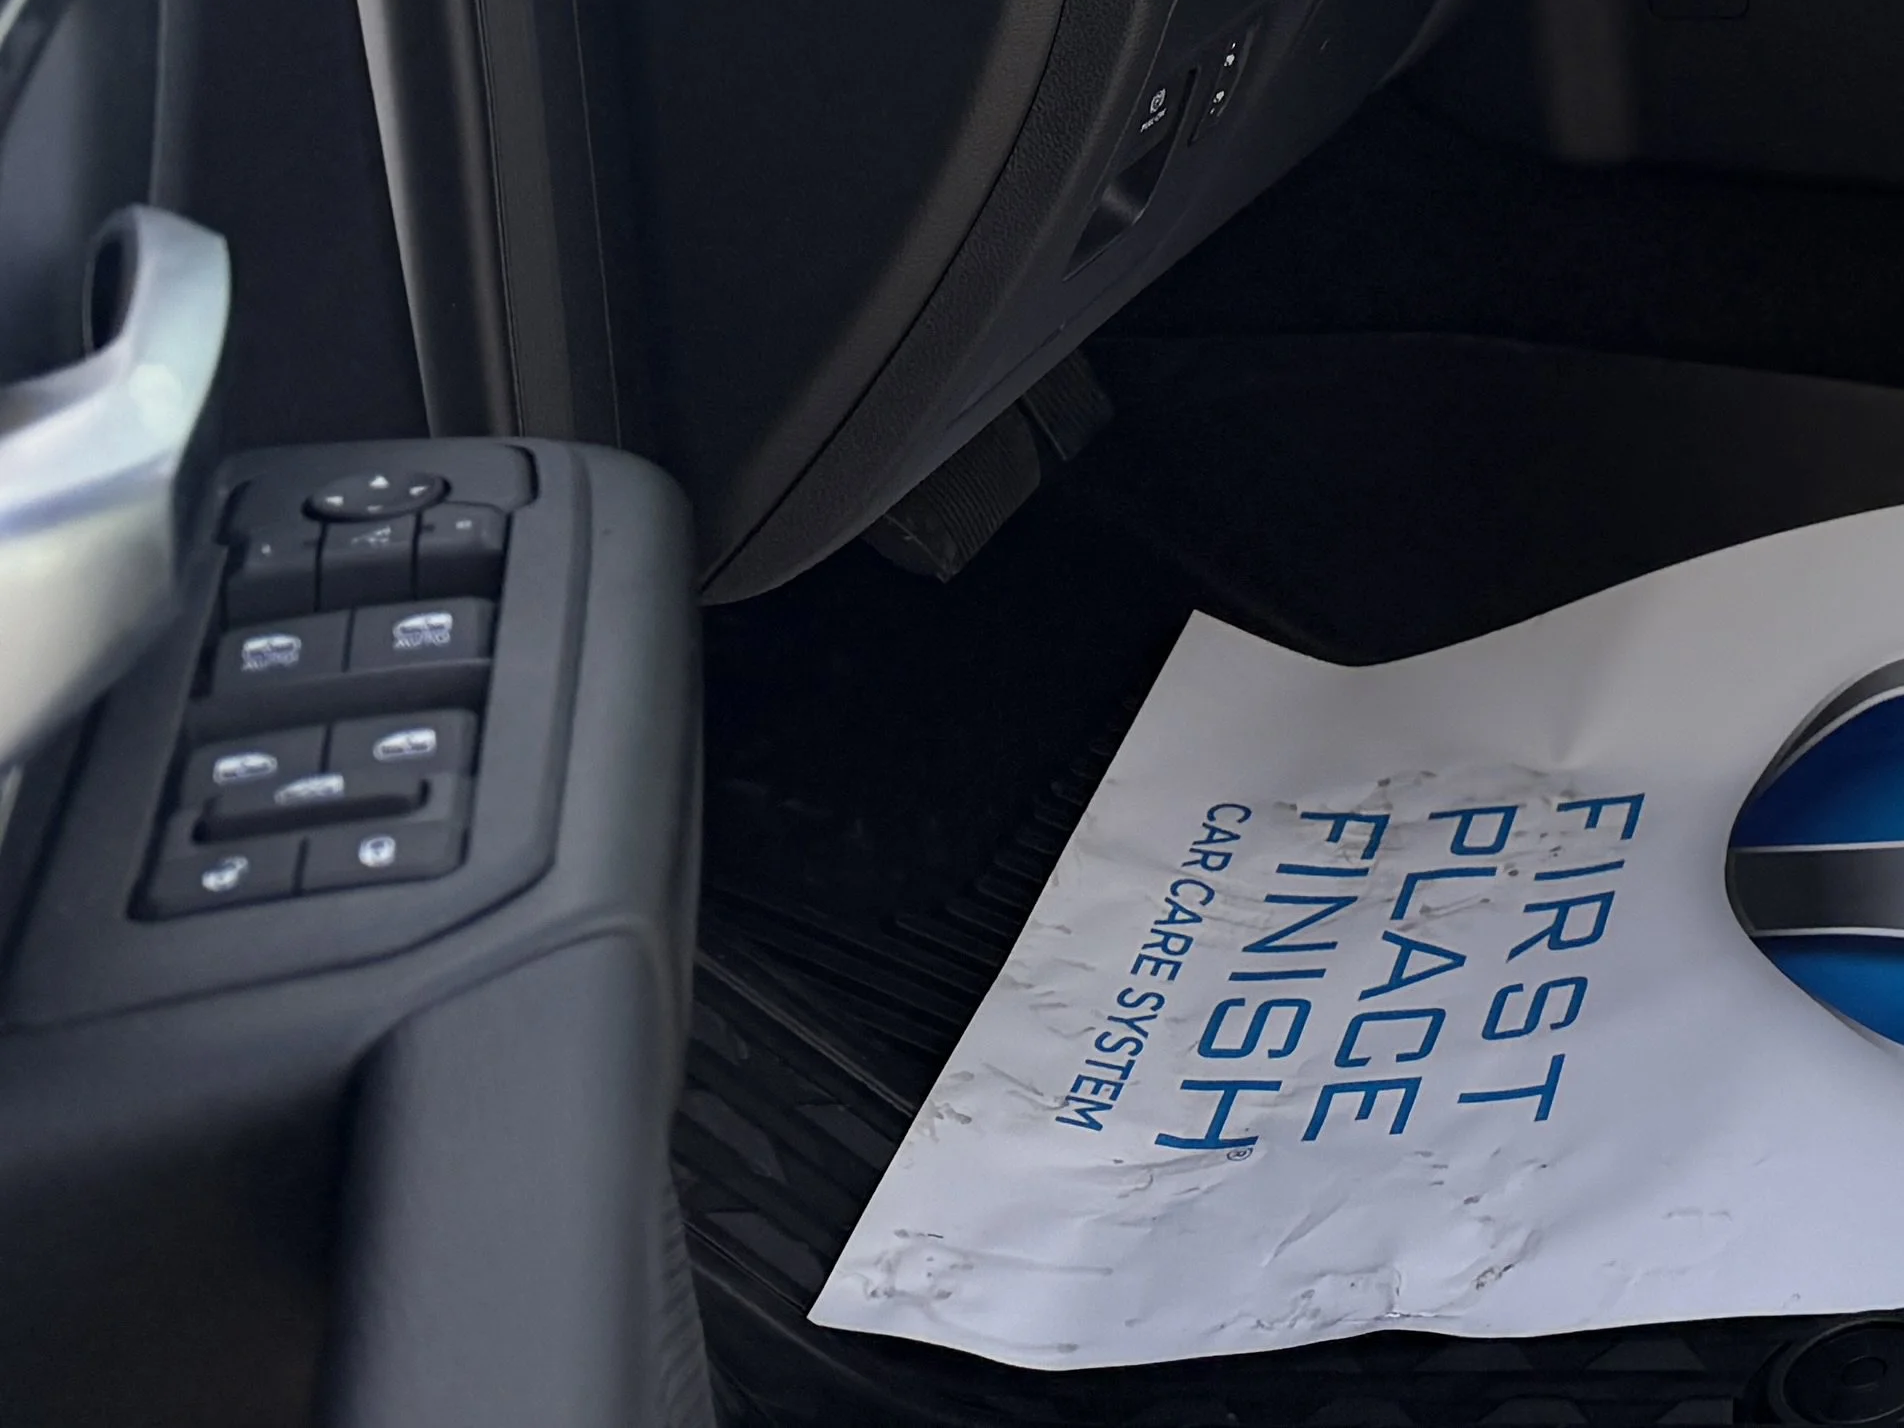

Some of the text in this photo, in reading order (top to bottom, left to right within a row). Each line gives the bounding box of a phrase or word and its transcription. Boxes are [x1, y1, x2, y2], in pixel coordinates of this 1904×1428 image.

[1054, 802, 1252, 1132] CAR CARE SYSTEM
[1302, 805, 1520, 1143] PLACE
[1456, 793, 1645, 1123] FIRST
